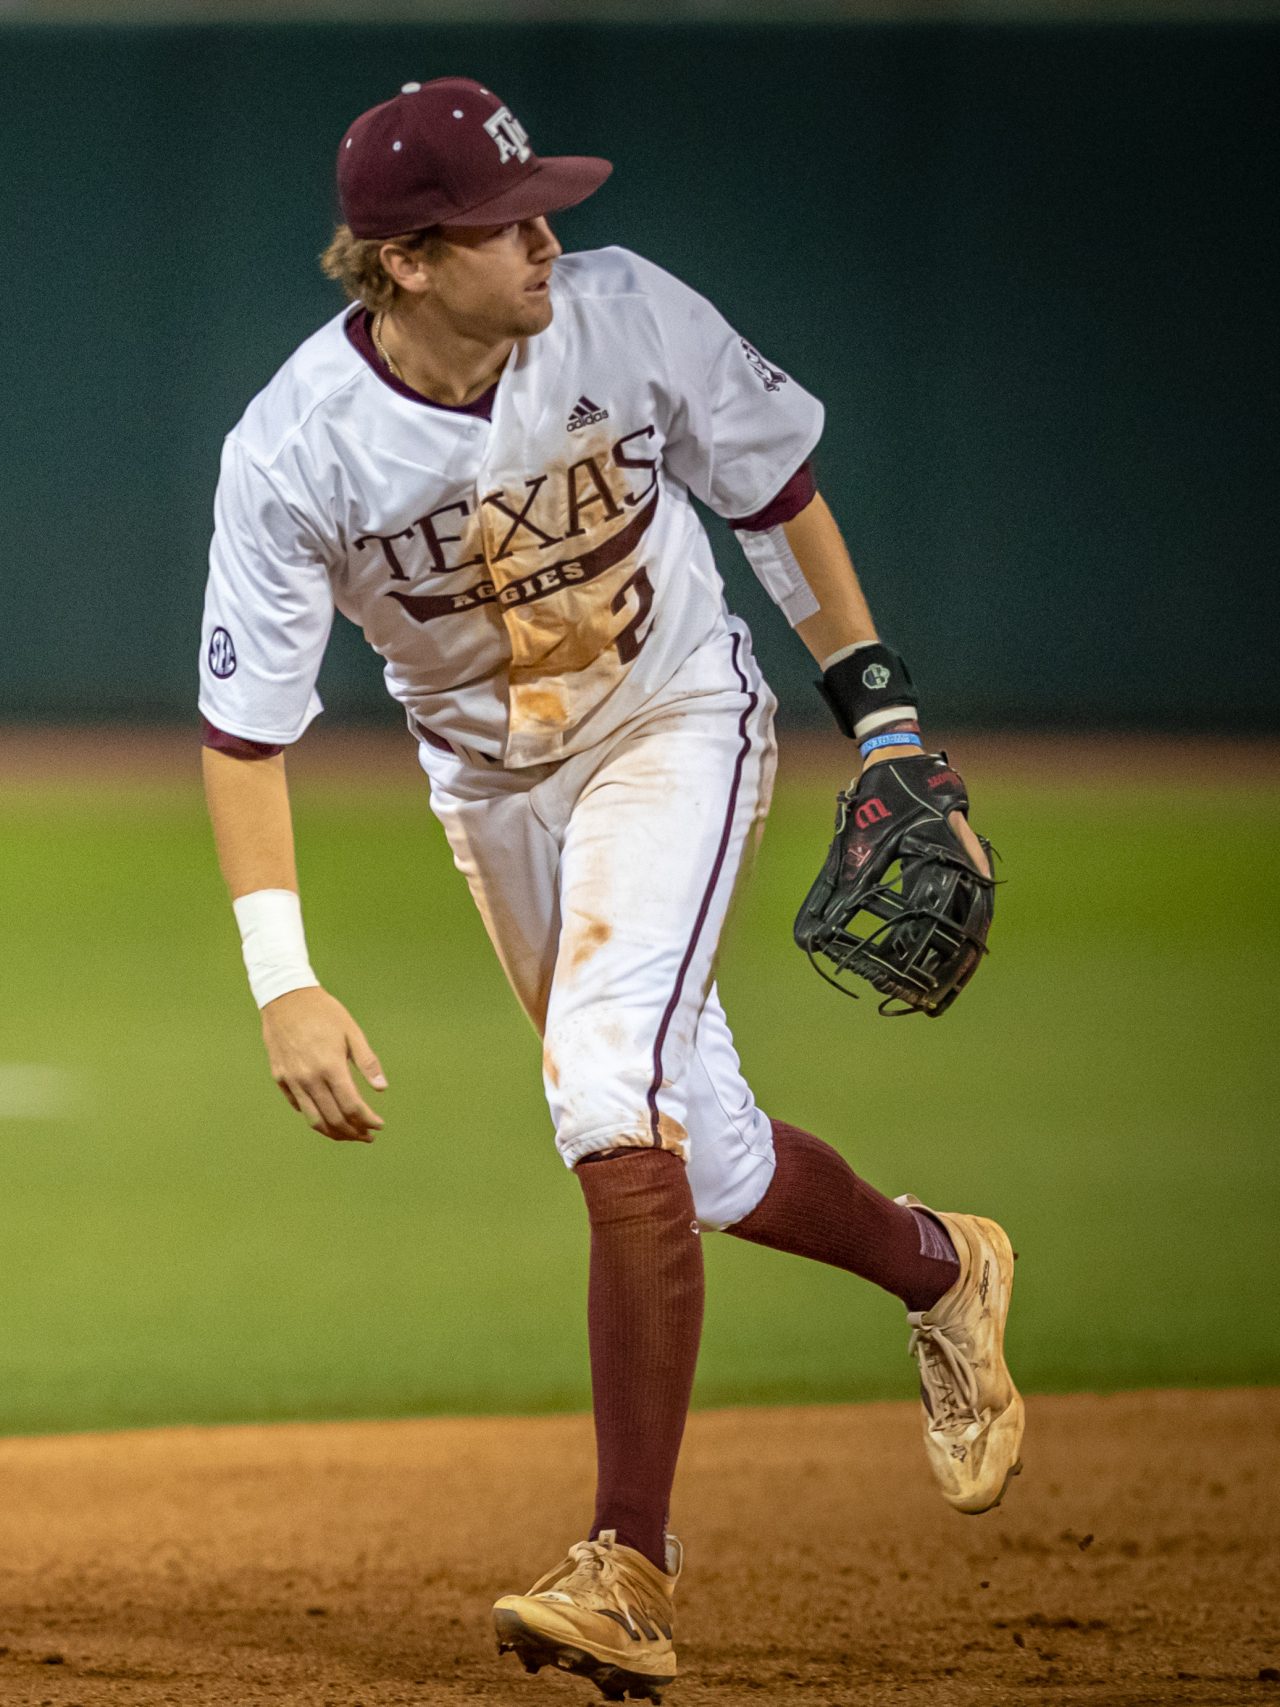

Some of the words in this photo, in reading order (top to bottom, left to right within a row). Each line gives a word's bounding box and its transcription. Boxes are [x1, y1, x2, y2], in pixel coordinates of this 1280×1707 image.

[567, 409, 609, 432] adidas
[354, 424, 658, 581] TEXAS
[451, 561, 585, 609] AGGIES
[611, 566, 656, 666] 2
